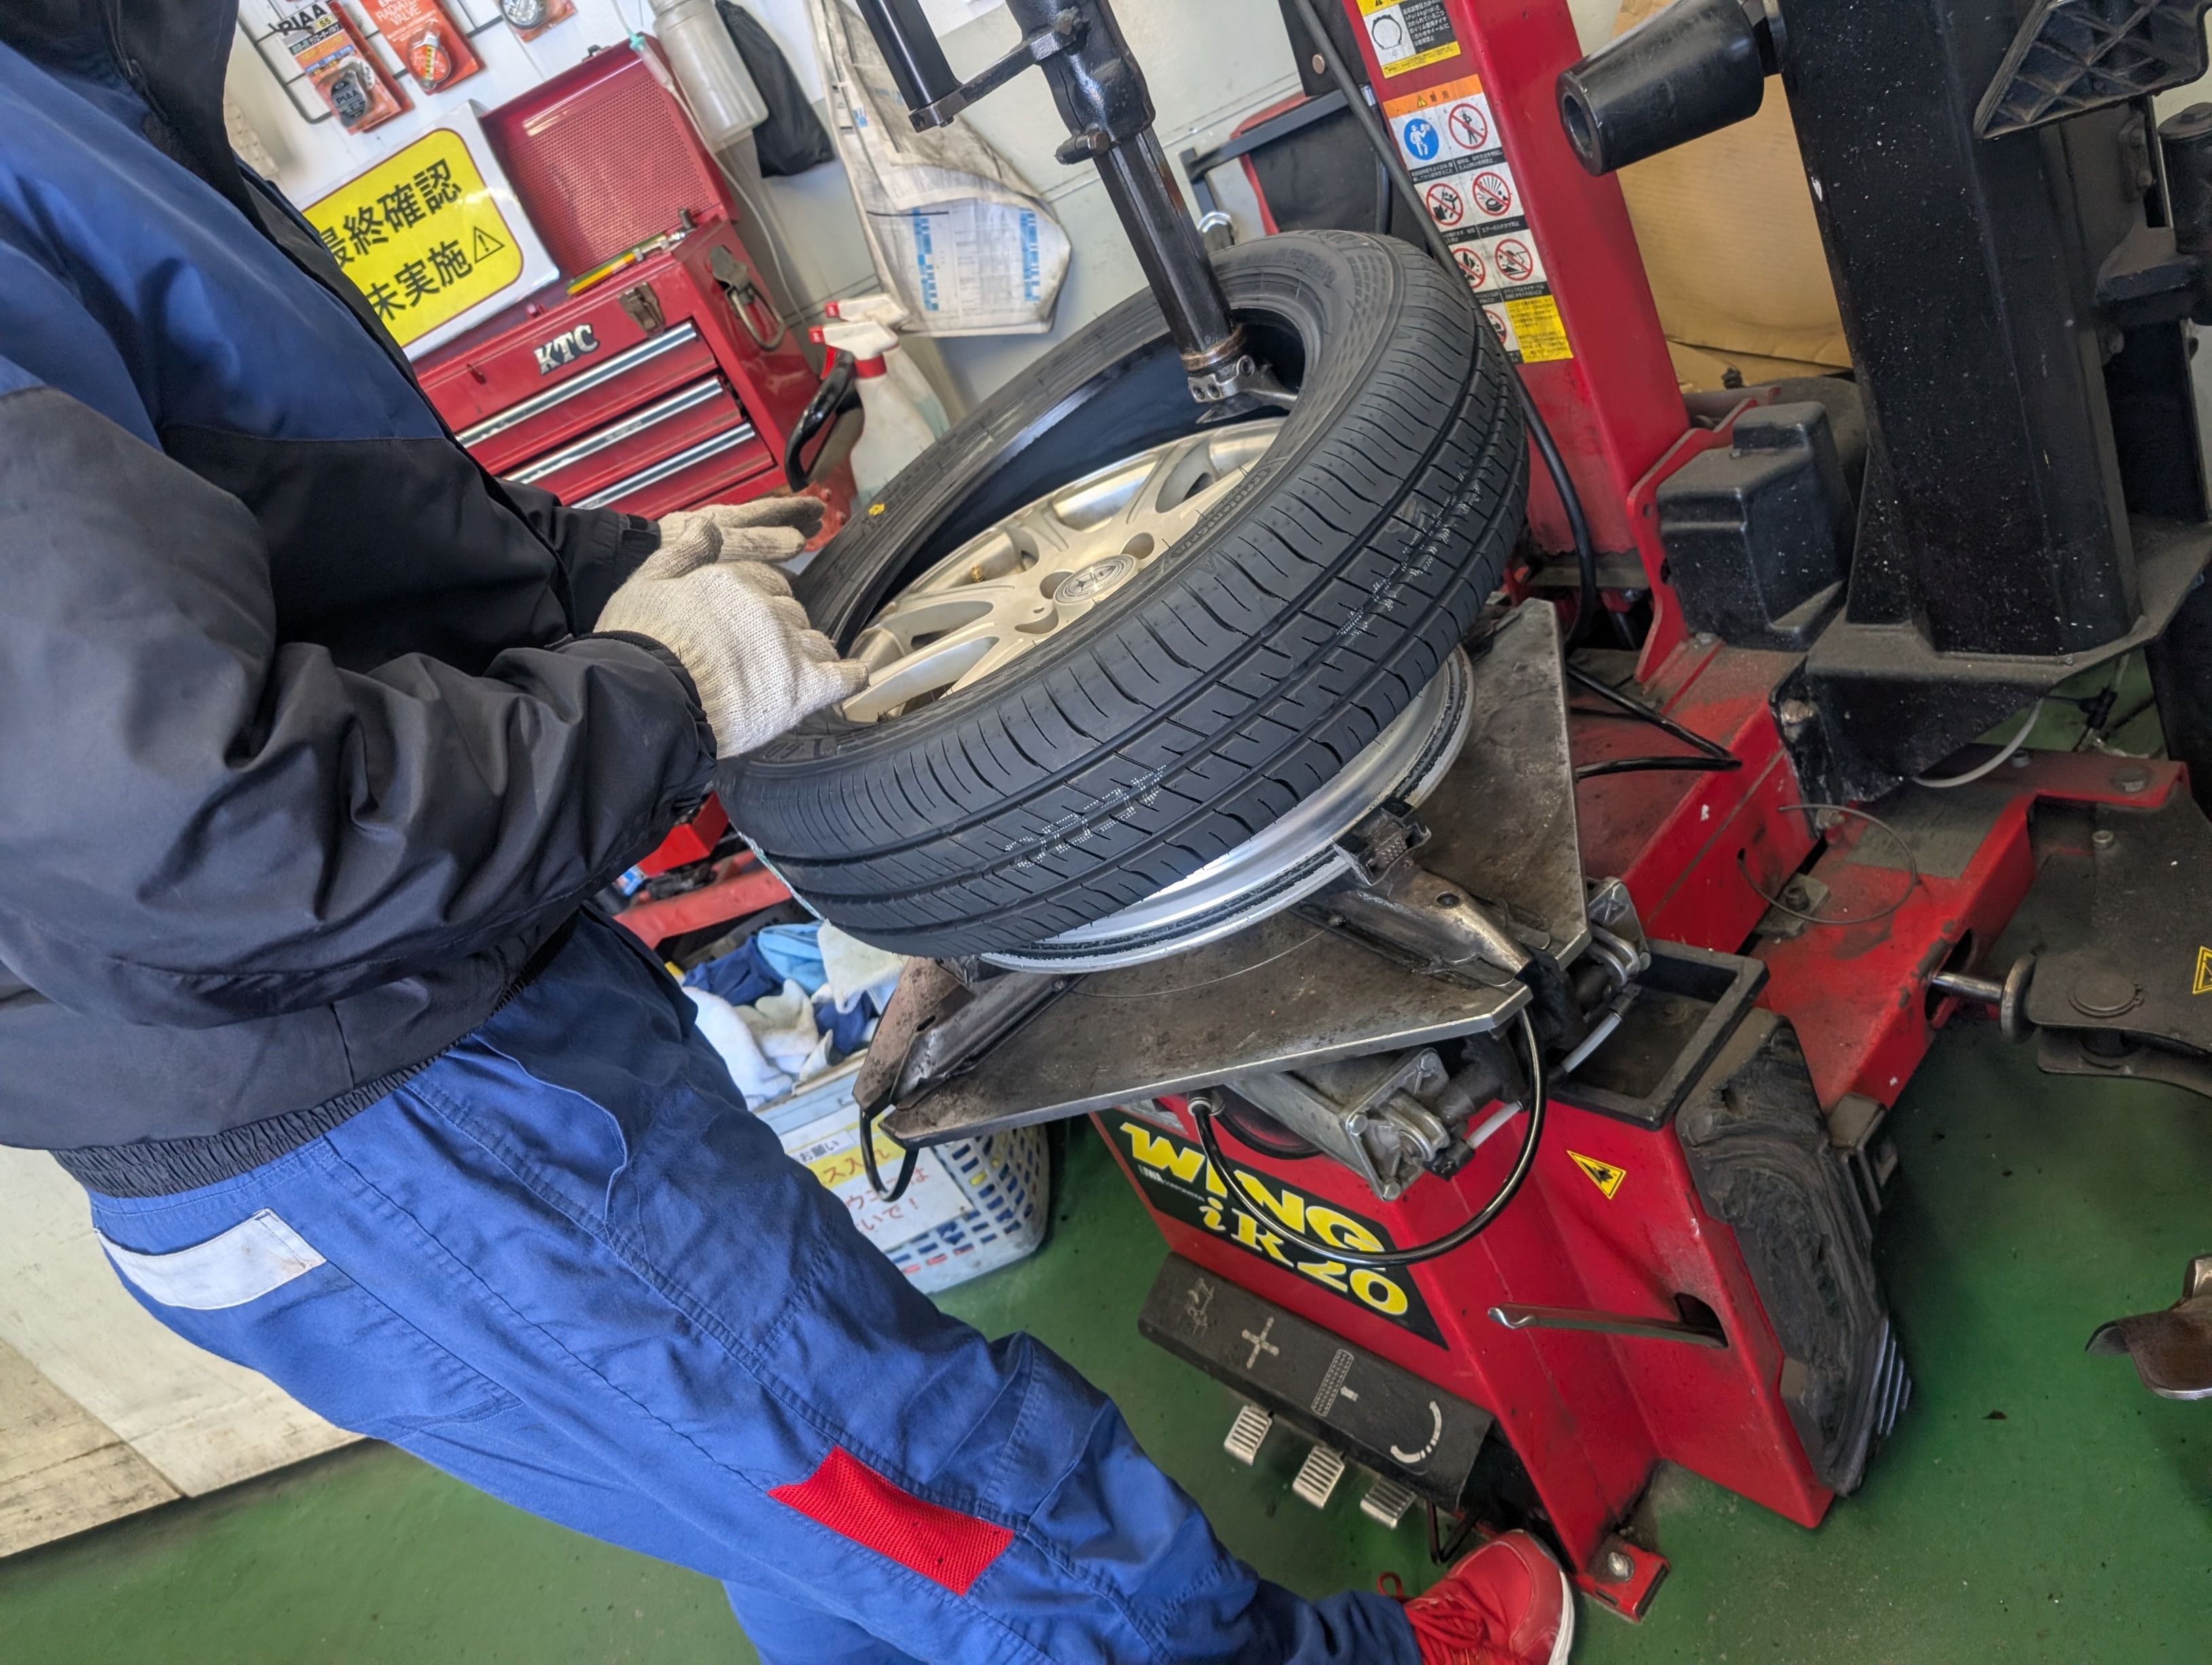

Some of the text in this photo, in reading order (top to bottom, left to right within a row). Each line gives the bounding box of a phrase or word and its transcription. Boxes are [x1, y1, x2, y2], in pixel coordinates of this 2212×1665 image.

[277, 3, 327, 36] PIAA
[319, 18, 331, 28] 55
[389, 3, 422, 26] VALVE
[336, 89, 359, 104] PIAA
[365, 240, 473, 321] 未実施
[533, 323, 600, 375] KTC
[1120, 1122, 1386, 1271] WING
